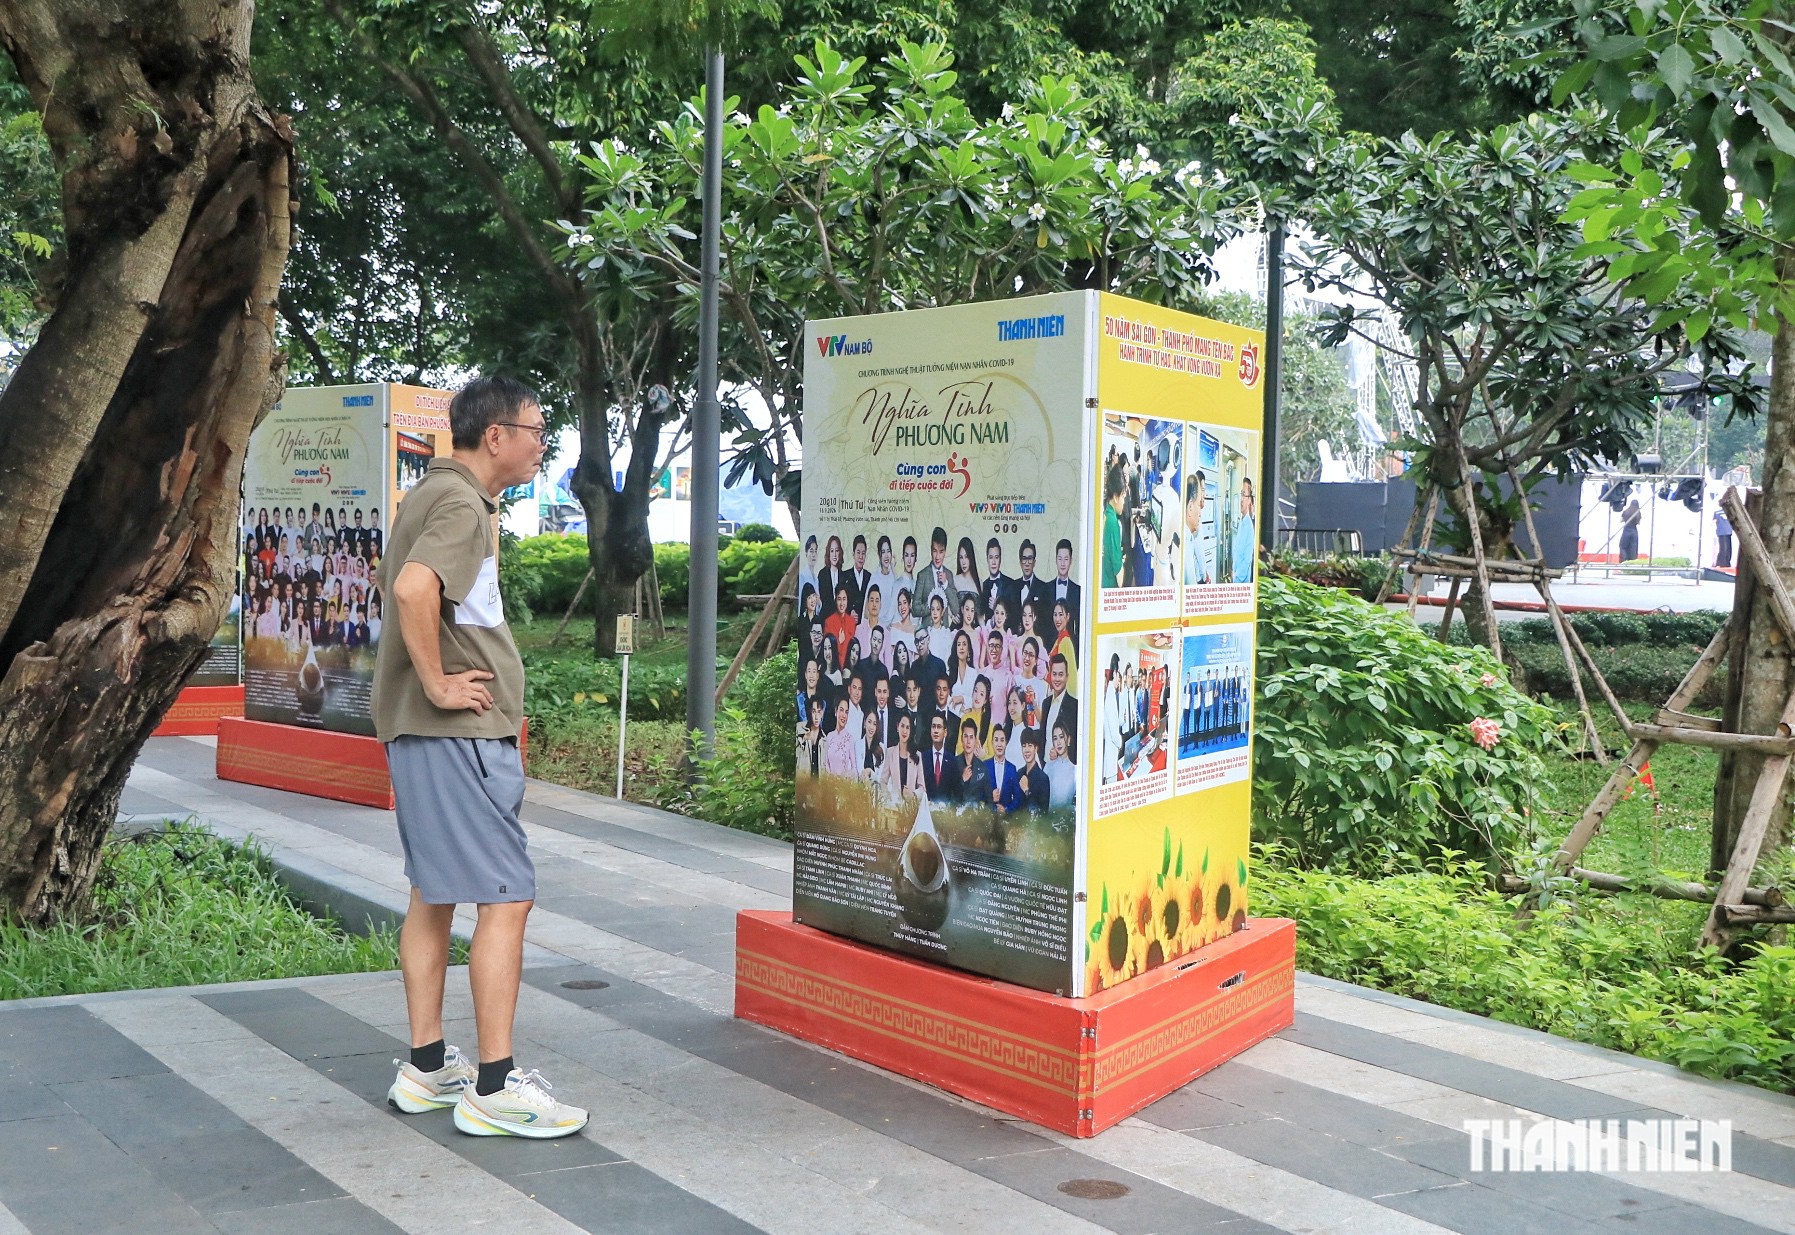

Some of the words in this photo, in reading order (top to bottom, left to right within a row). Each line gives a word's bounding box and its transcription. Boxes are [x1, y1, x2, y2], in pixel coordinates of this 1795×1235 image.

[998, 318, 1035, 341] THANH
[1037, 314, 1064, 338] NIÊN
[1106, 316, 1114, 336] 50
[1115, 317, 1130, 340] NĂM
[1132, 320, 1142, 342] SÀI
[1144, 322, 1156, 345] GÒN
[1162, 328, 1180, 350] THÀNH
[1182, 331, 1193, 352] PHỐ
[1195, 337, 1210, 356] MANG
[1212, 339, 1222, 359] TÊN
[816, 335, 846, 357] VTV
[845, 343, 860, 356] NAM
[862, 338, 872, 356] BỘ
[1120, 342, 1134, 361] HÀNH
[1136, 345, 1152, 364] TRÌNH
[1215, 362, 1220, 377] XA
[858, 368, 879, 378] CHƯƠNG
[895, 365, 908, 375] NGHỆ
[909, 364, 925, 374] THUẬT
[926, 362, 944, 372] TƯỞNG
[959, 361, 971, 371] NẠN
[972, 359, 987, 369] NHÂN
[988, 358, 1014, 367] COVID-19
[394, 412, 406, 425] TRÊN
[856, 388, 932, 456] Nghĩa
[938, 382, 994, 426] Tình
[896, 424, 964, 446] PHƯƠNG
[970, 422, 1008, 444] NAM
[294, 448, 328, 460] PHƯƠNG
[330, 448, 349, 460] NAM
[295, 469, 308, 477] Cùng
[897, 462, 924, 478] Cùng
[927, 464, 946, 475] con
[889, 480, 897, 490] đi
[899, 479, 915, 492] tiếp
[918, 480, 937, 492] cuộc
[940, 479, 953, 490] đời
[819, 497, 836, 506] 20g10
[840, 499, 853, 509] Thứ
[970, 502, 988, 513] VTV9
[990, 502, 1011, 513] VTV10
[1002, 886, 1019, 894] QUANG
[1049, 925, 1066, 933] PHONG
